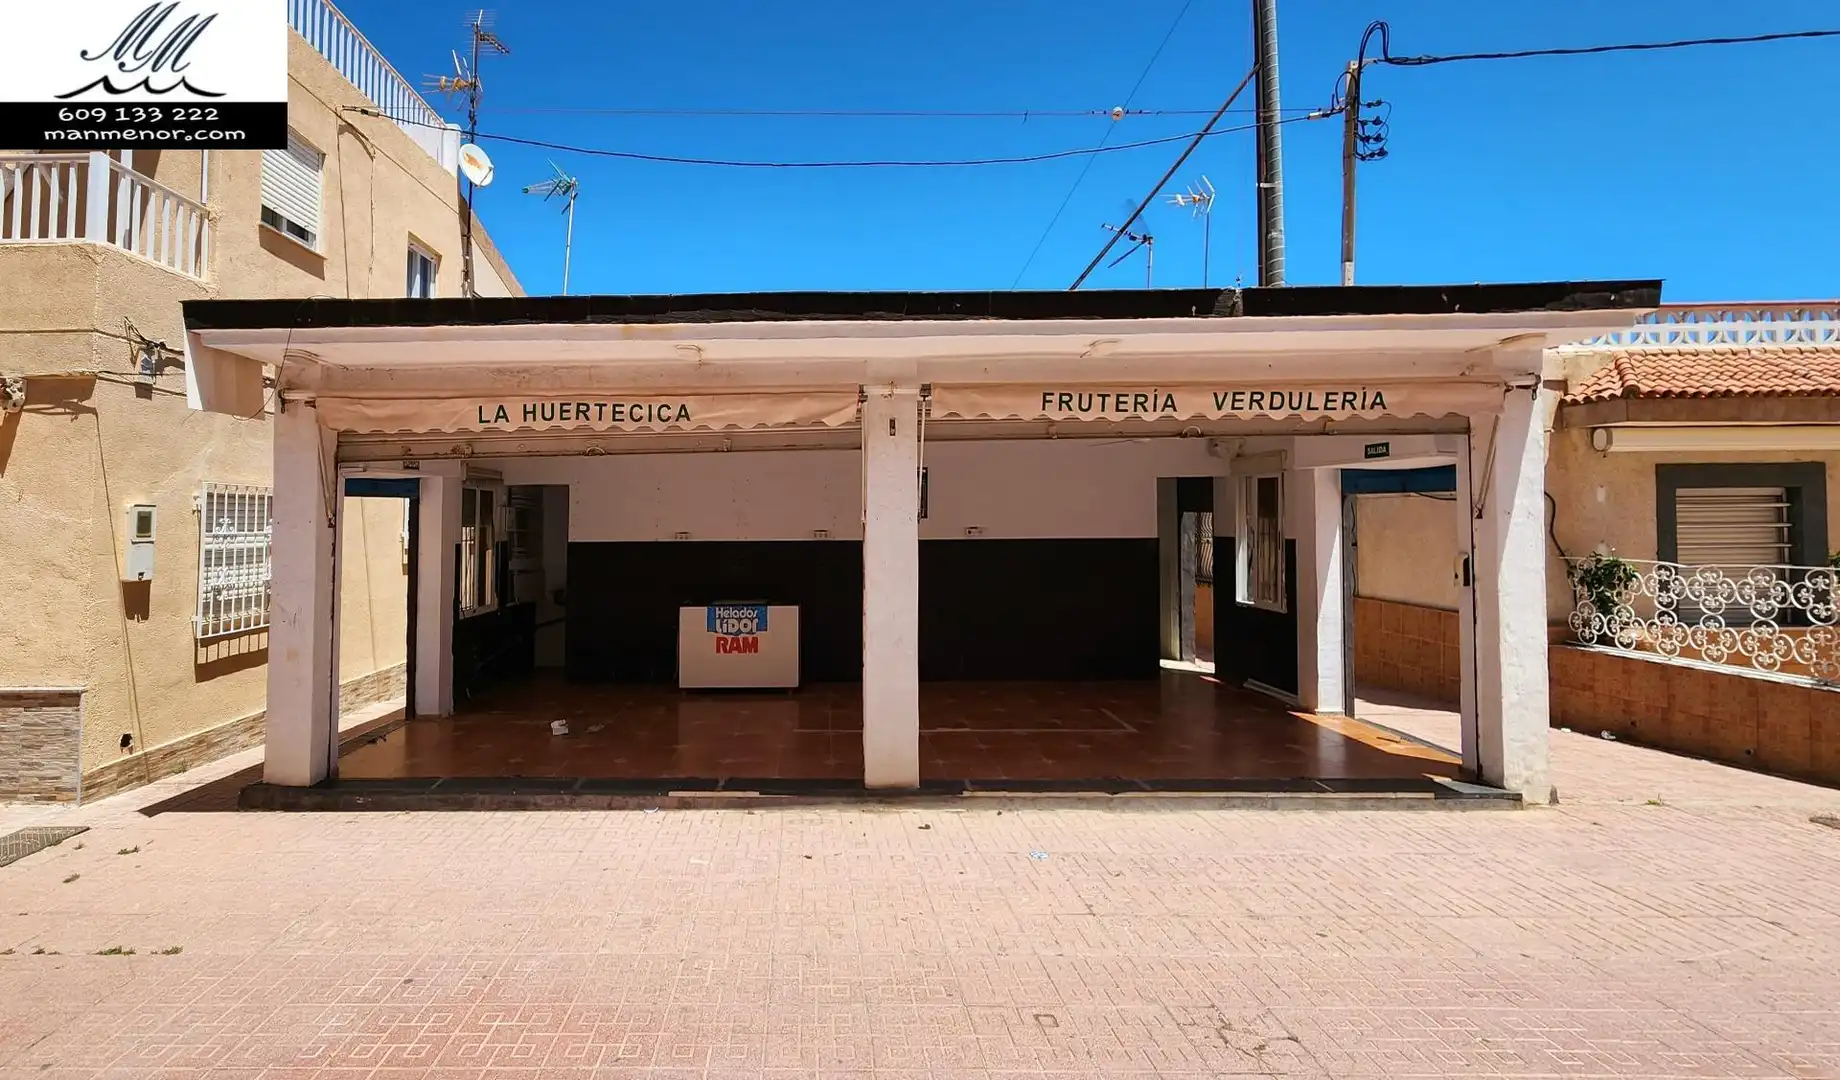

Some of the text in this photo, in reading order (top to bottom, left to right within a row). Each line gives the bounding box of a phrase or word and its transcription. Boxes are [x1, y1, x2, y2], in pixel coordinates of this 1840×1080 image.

[1041, 386, 1388, 413] FRUTERÍA VERDULERÍA
[478, 402, 692, 424] LA HUERTECICA
[715, 607, 758, 618] Helados
[715, 636, 759, 654] RAM
